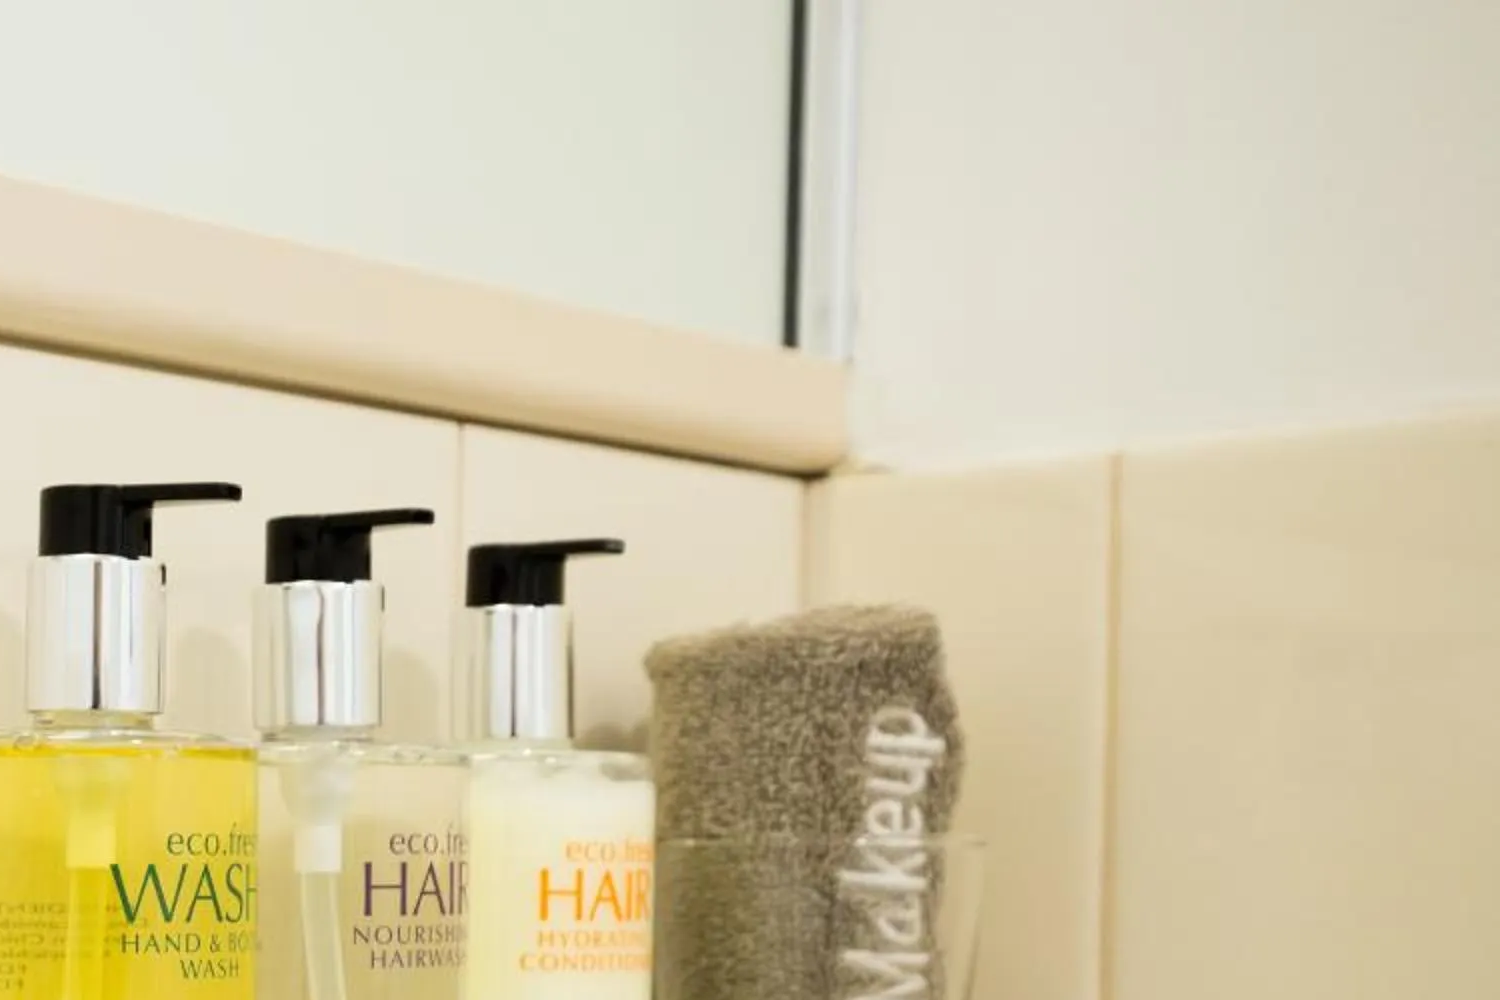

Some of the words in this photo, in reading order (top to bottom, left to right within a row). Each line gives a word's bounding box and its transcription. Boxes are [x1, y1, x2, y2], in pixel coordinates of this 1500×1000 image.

[110, 863, 257, 924] WASH
[364, 861, 469, 916] HAIR
[539, 867, 650, 921] HAIR
[121, 932, 201, 954] HAND
[209, 932, 221, 953] &
[180, 959, 239, 979] WASH
